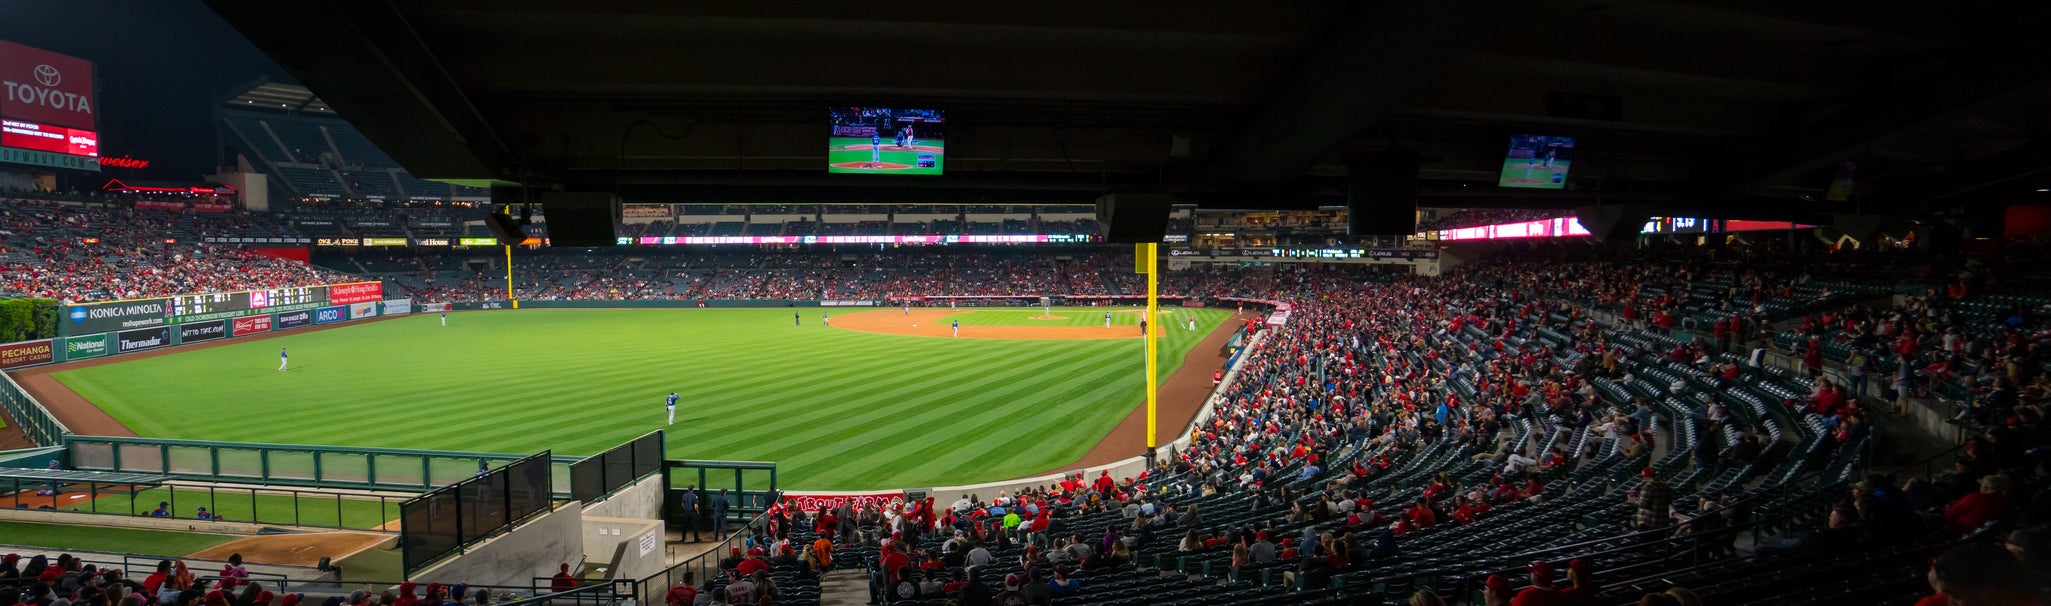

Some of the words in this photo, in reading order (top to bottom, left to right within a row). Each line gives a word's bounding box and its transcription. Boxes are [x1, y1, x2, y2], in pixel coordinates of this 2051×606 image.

[3, 80, 91, 114] TOYOTA
[414, 238, 428, 246] Yard
[429, 238, 449, 246] House
[90, 306, 125, 319] KONICA
[126, 303, 162, 316] MINOLTA
[185, 314, 195, 322] OLD
[195, 313, 218, 321] DOMINION
[218, 311, 235, 319] FREIGHT
[318, 310, 338, 322] ARCO
[122, 317, 163, 328] reshapework.com
[182, 327, 199, 337] NITTO
[76, 339, 105, 350] National
[121, 336, 161, 350] Thermador
[2, 345, 50, 358] PECHANGA
[2, 356, 26, 365] RESORT
[29, 353, 51, 362] CASINO
[798, 496, 843, 511] TROUT
[847, 495, 889, 511] FARM
